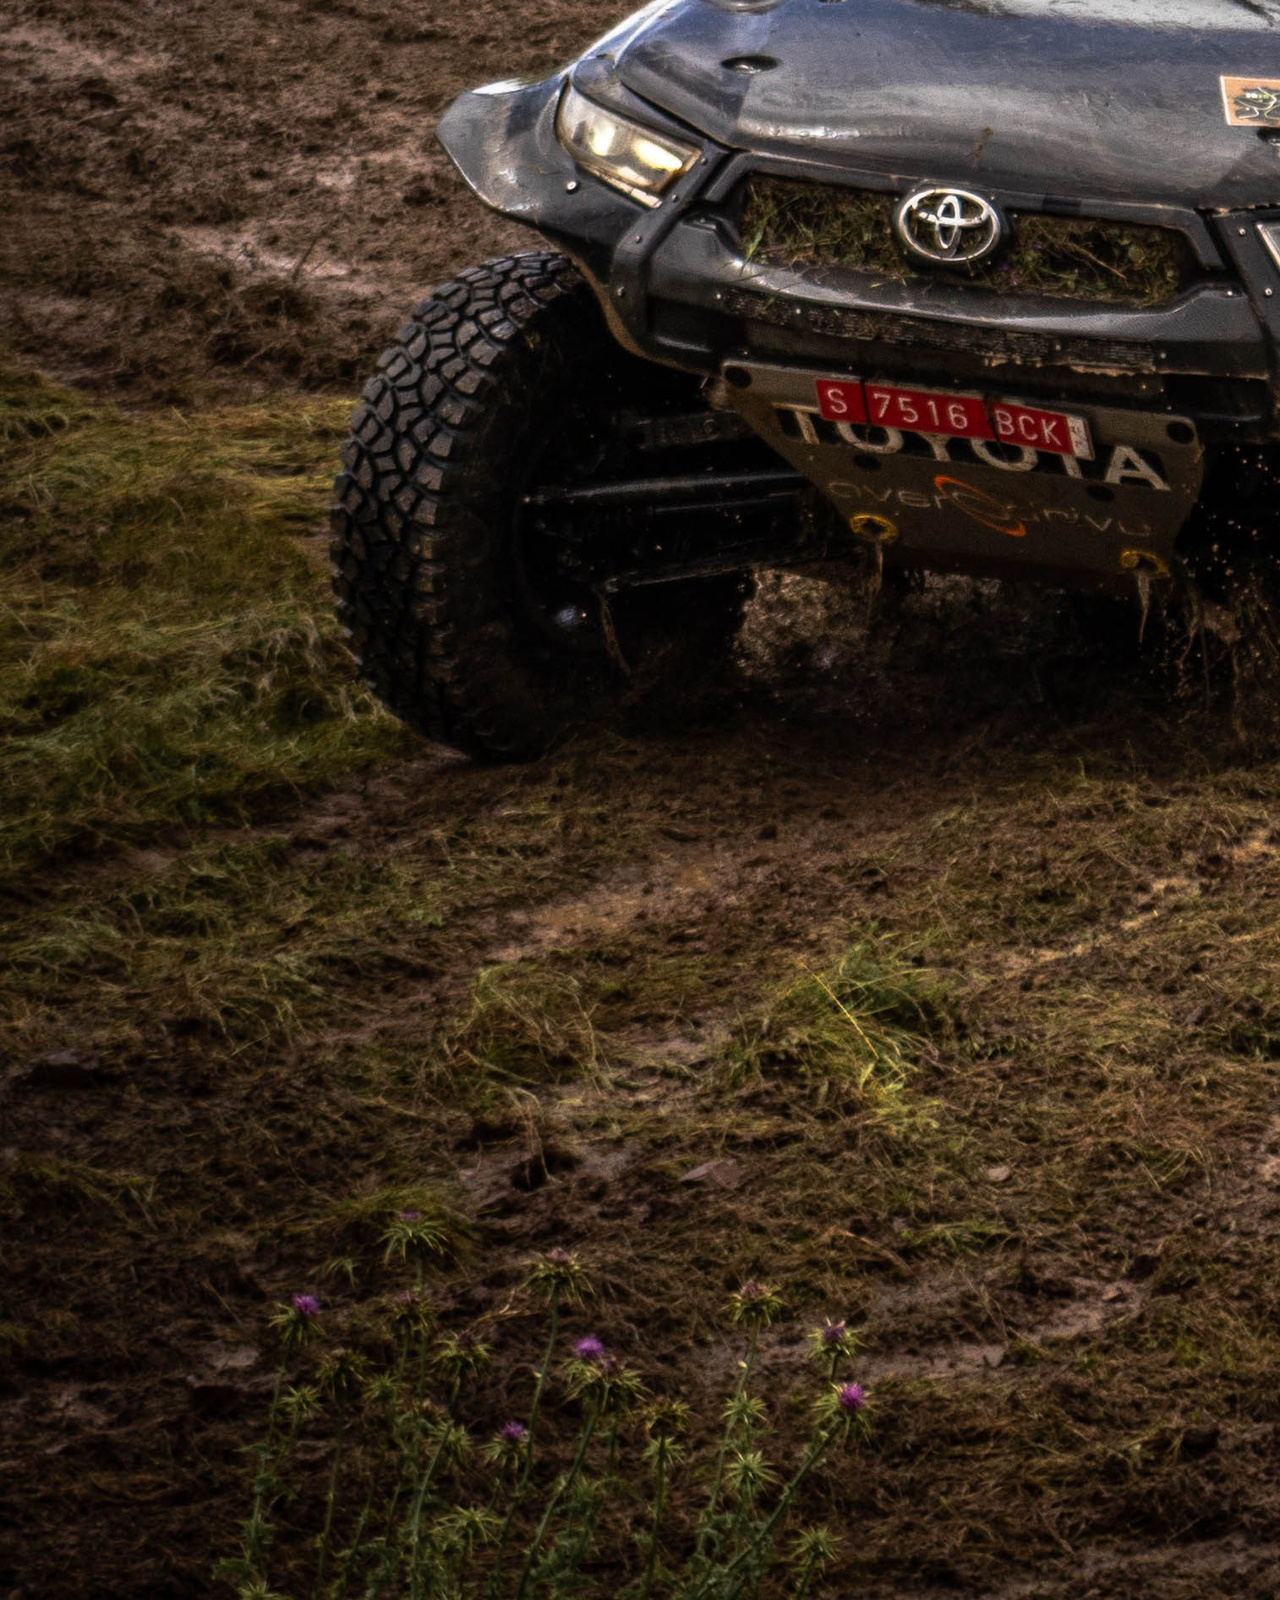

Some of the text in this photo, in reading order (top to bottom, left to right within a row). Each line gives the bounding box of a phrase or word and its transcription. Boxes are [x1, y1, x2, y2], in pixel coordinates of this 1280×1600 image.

[827, 388, 1062, 446] S 7516 BCK
